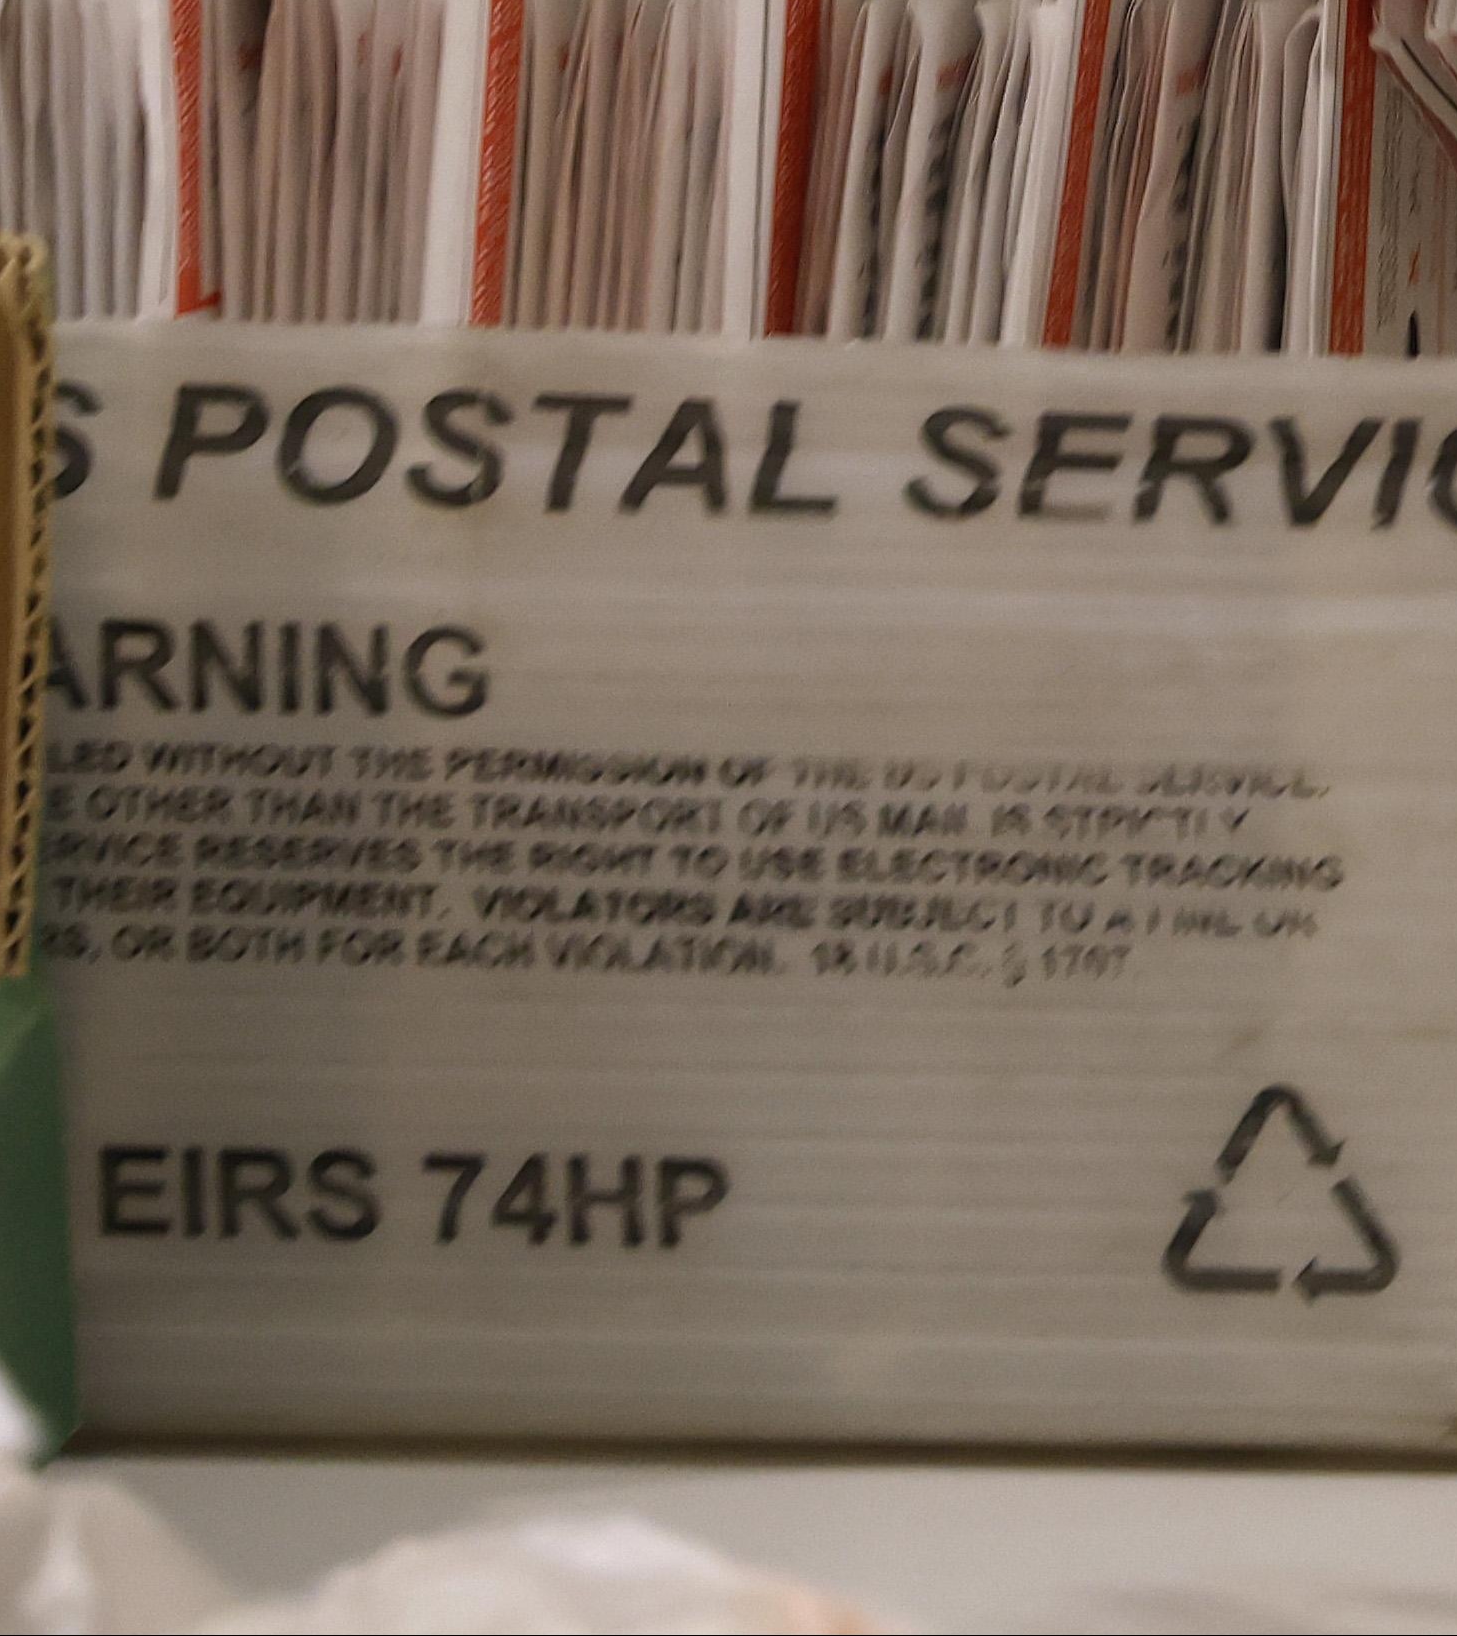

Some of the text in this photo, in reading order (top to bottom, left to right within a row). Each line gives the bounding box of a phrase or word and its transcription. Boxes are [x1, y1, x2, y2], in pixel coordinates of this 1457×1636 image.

[49, 378, 104, 501] S
[153, 380, 841, 517] POSTAL
[43, 616, 492, 719] ARNING
[145, 742, 339, 778] WITHOUT
[350, 745, 432, 781] THE
[443, 745, 708, 787] PERMISSION
[718, 754, 771, 789] OF
[84, 784, 234, 824] OTHER
[245, 787, 361, 827] THAN
[374, 791, 456, 830] THE
[470, 791, 723, 835] TRANSPORT
[737, 797, 795, 837] OF
[194, 833, 423, 872] RESERVES
[433, 838, 516, 874] THE
[527, 839, 660, 876] RIGHT
[669, 843, 729, 879] TO
[738, 845, 826, 881] USE
[837, 846, 1108, 886] ELECTRONIC
[1120, 851, 1345, 892] TRACKING
[52, 875, 180, 913] THEIR
[472, 882, 717, 926] VIOLATORS
[727, 891, 816, 930] ARE
[827, 893, 1018, 933] SUBJECT
[110, 923, 177, 964] OR
[186, 923, 306, 965] BOTH
[317, 925, 408, 966] FOR
[416, 927, 536, 968] EACH
[809, 937, 860, 977] 18
[97, 1144, 732, 1249] EIRS 74HP
